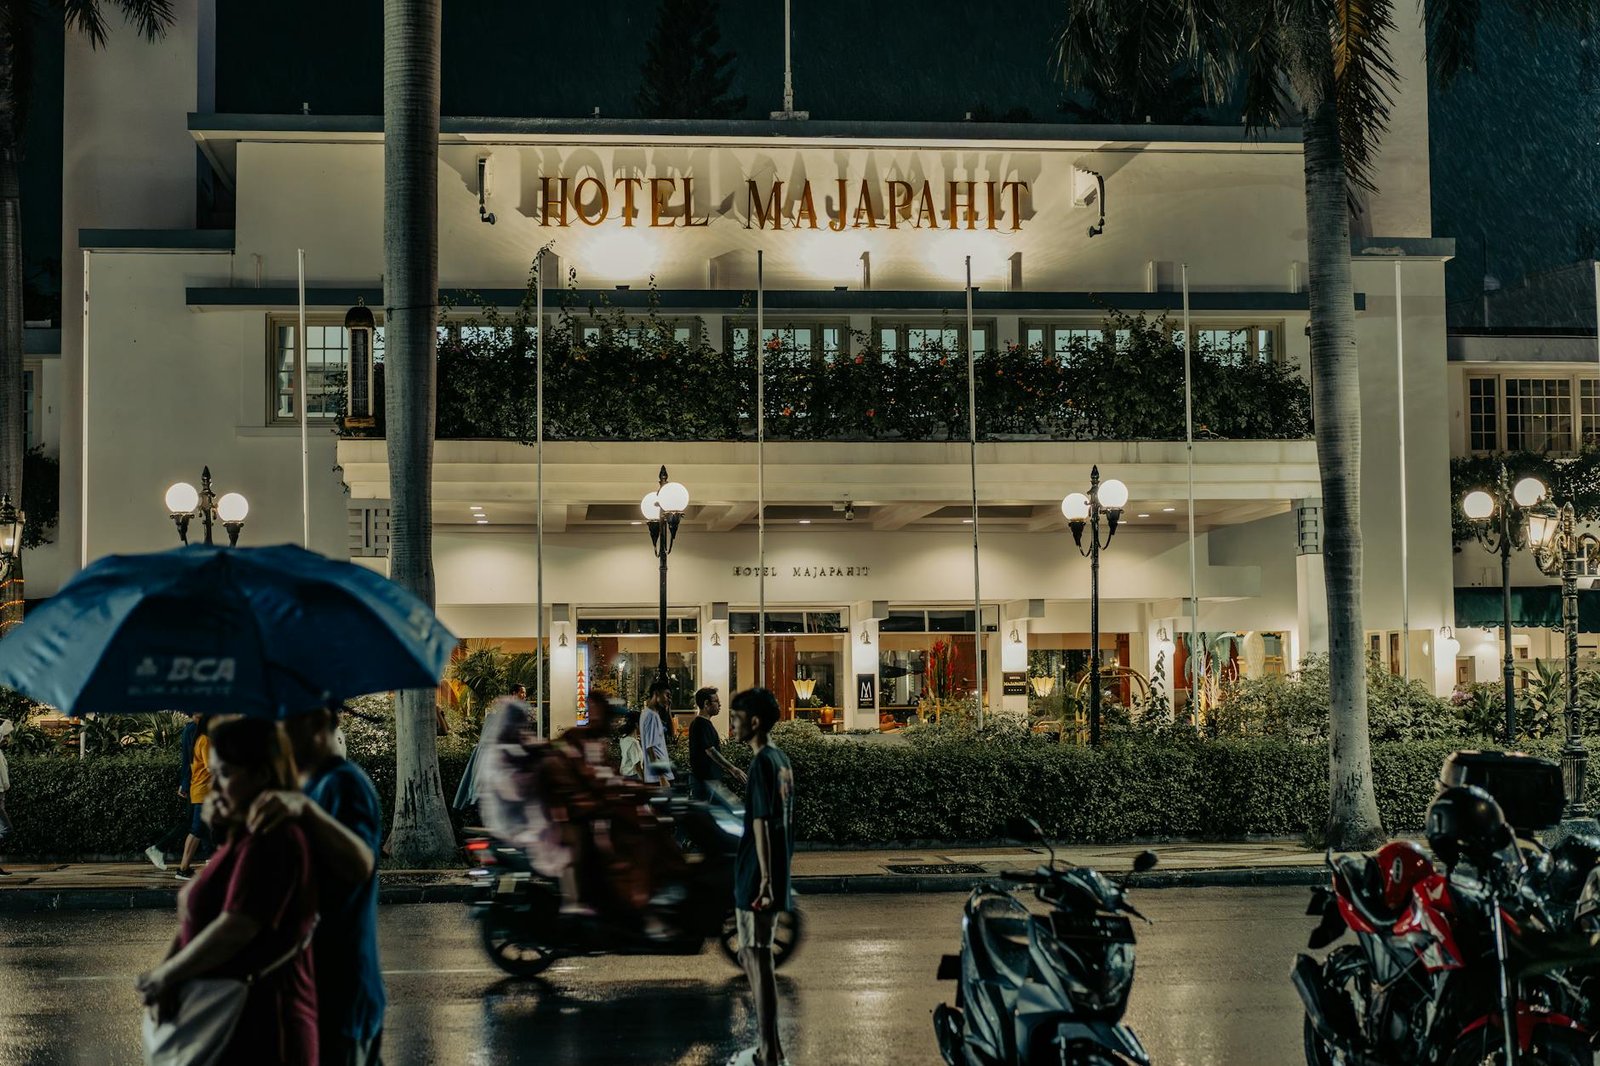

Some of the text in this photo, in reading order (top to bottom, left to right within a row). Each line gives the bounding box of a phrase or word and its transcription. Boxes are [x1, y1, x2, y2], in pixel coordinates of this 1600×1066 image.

[538, 176, 1029, 231] HOTEL MAJAPAHIT
[732, 566, 870, 578] HOTEL MAJAPAHIT
[167, 657, 236, 681] BCA
